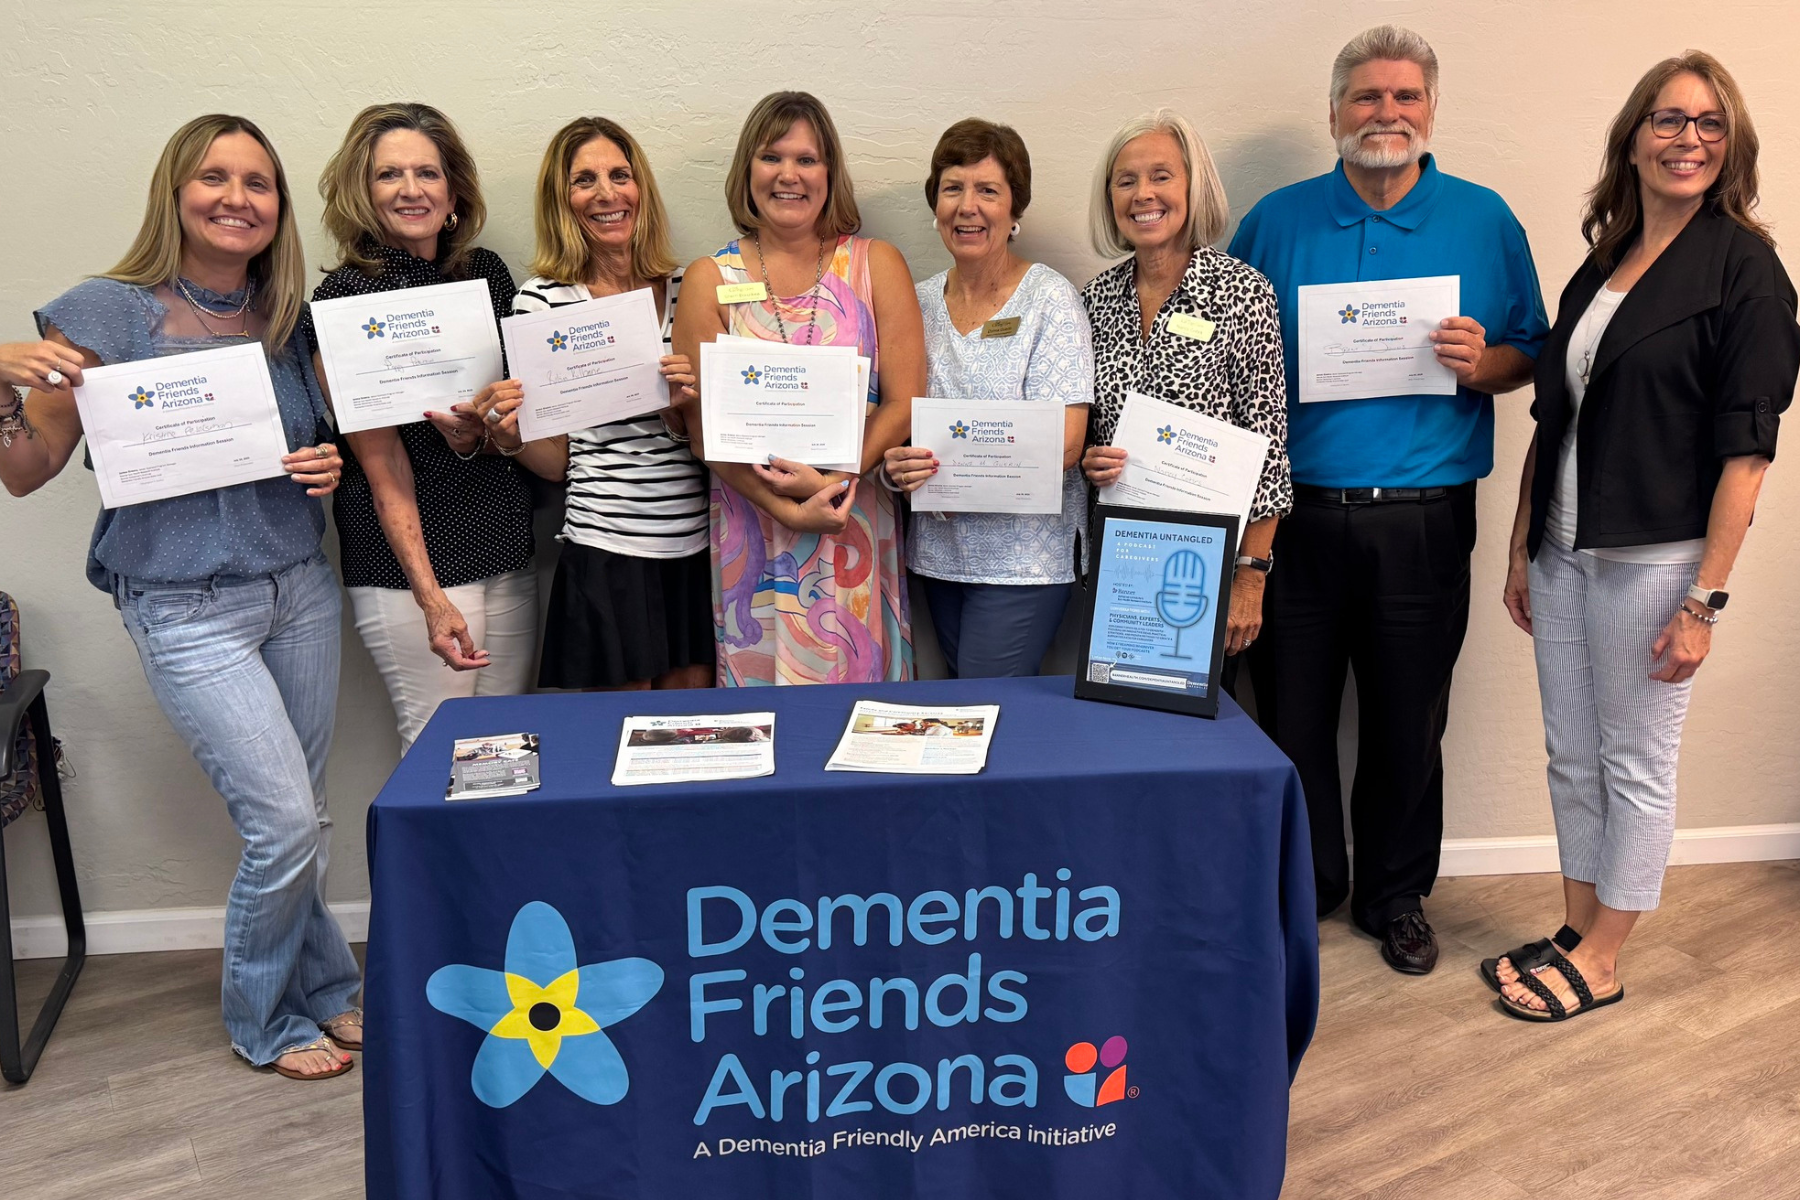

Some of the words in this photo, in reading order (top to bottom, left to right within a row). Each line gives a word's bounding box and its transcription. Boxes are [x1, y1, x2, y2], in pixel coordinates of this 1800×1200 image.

[1362, 300, 1405, 310] Dementia
[386, 309, 434, 322] Dementia
[1362, 309, 1396, 318] Friends
[388, 319, 426, 330] Friends
[569, 320, 610, 334] Dementia
[1362, 318, 1397, 326] Arizona
[392, 328, 430, 340] Arizona
[570, 330, 603, 343] Friends
[573, 339, 606, 352] Arizona
[764, 365, 806, 374] Dementia
[156, 376, 207, 391] Dementia
[764, 373, 798, 382] Friends
[764, 382, 799, 390] Arizona
[158, 387, 199, 400] Friends
[162, 396, 203, 410] Arizona
[972, 436, 1006, 444] Arizona
[1177, 436, 1208, 452] Friends
[1180, 429, 1218, 448] Dementia
[1175, 445, 1206, 460] Arizona
[1115, 530, 1158, 540] DEMENTIA
[1160, 533, 1213, 544] UNTANGLED
[1116, 554, 1159, 562] CAREGIVERS
[686, 868, 1120, 958] Dementia
[689, 953, 1028, 1043] Friends
[692, 1050, 1038, 1126] Arizona
[693, 1142, 712, 1159] A
[719, 1138, 826, 1157] Dementia
[833, 1128, 924, 1153] Friendly
[929, 1121, 1020, 1147] America
[1028, 1123, 1117, 1146] initiative
